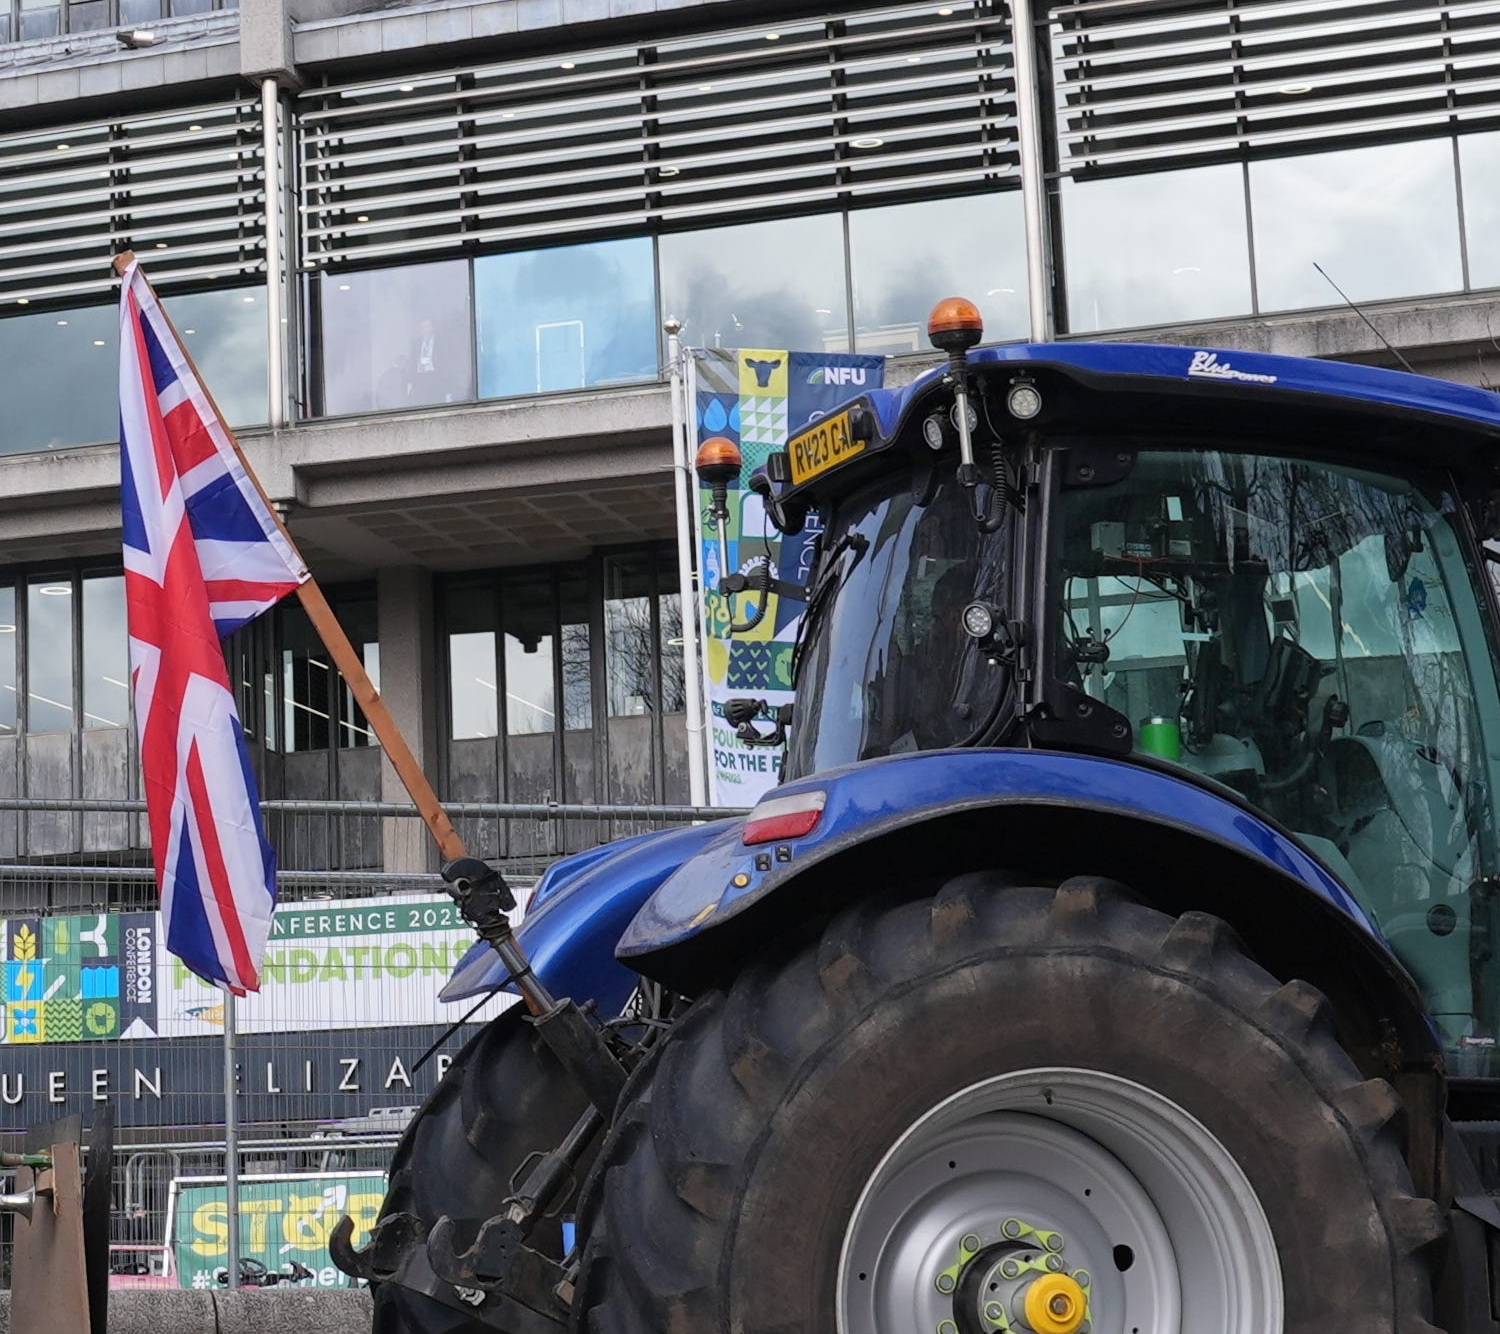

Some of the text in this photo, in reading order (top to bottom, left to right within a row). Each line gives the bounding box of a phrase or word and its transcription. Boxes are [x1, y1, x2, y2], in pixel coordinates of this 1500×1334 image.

[824, 367, 866, 385] NFU
[714, 749, 737, 769] FOR
[738, 754, 768, 773] THE
[272, 910, 397, 936] NFERENCE
[125, 927, 137, 1004] CONFERENCE
[136, 927, 152, 1004] LONDON
